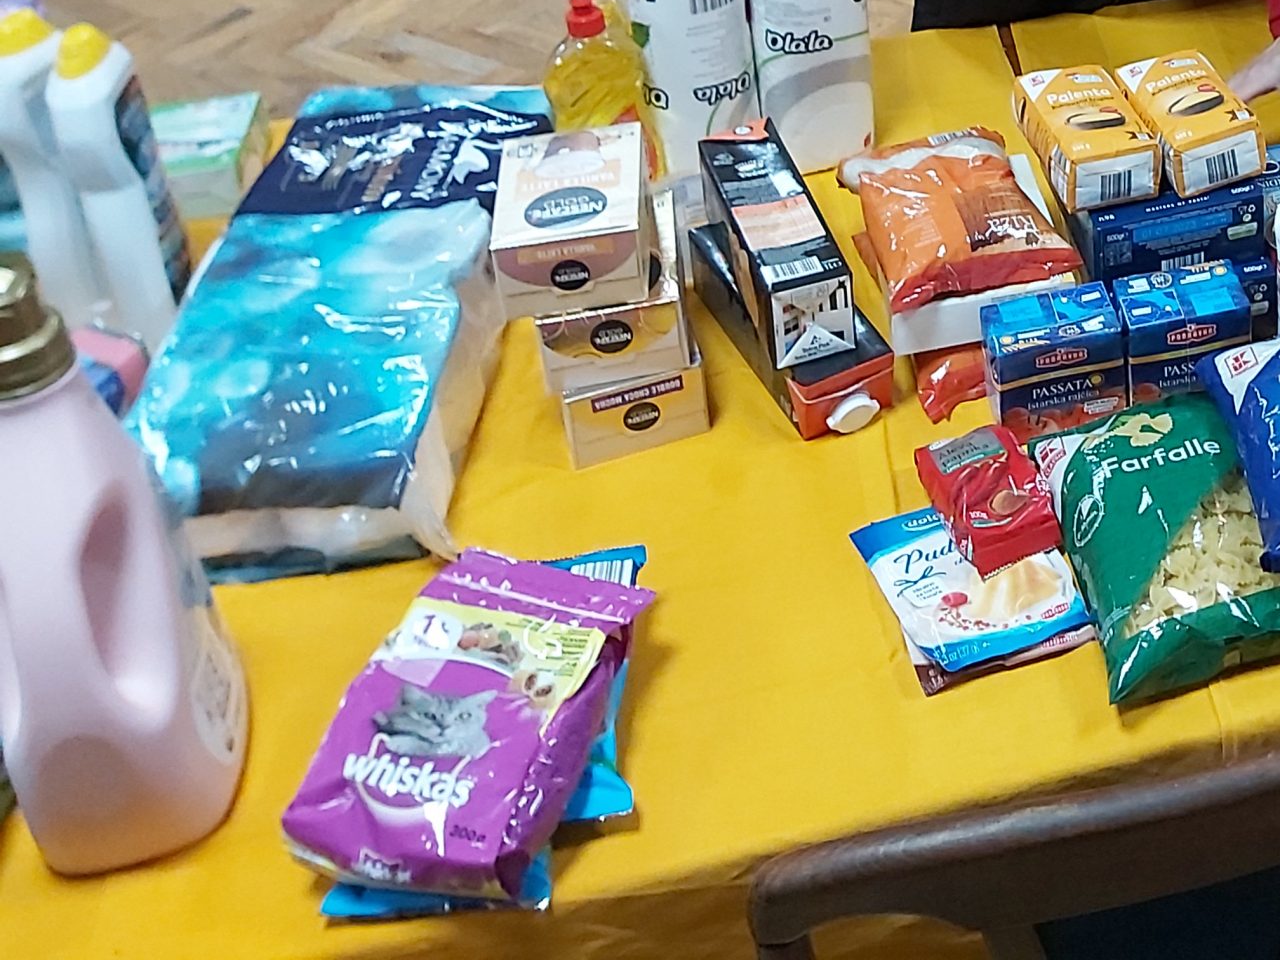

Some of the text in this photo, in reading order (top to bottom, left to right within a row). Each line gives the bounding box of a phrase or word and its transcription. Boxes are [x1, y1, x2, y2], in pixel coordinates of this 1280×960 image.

[1046, 88, 1111, 106] Palenta
[1163, 361, 1196, 377] PASS
[1033, 378, 1094, 399] PASSATA
[1027, 394, 1066, 411] Istarska
[1101, 438, 1222, 480] Farfalle
[907, 514, 940, 528] dolc
[893, 538, 955, 574] Pud
[343, 753, 475, 809] whiskas
